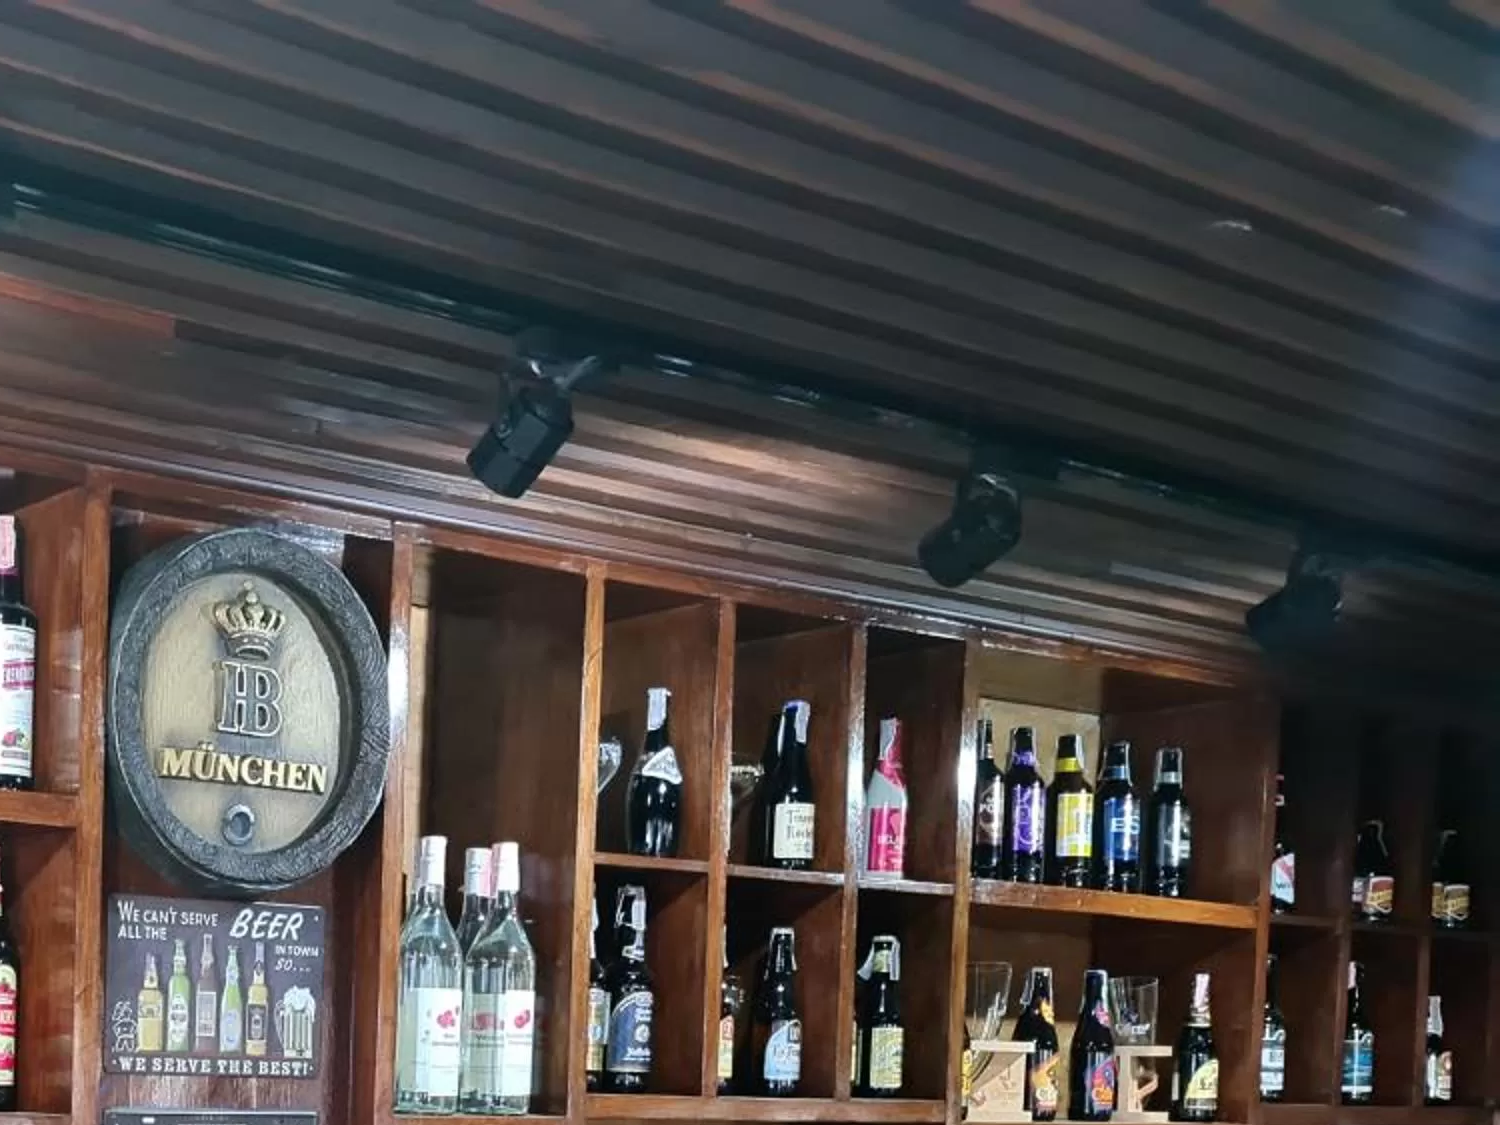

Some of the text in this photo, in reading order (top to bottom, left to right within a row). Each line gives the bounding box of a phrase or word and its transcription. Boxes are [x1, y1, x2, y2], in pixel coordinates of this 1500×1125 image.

[213, 659, 284, 738] HB
[160, 741, 328, 794] MÜNCHEN
[118, 925, 167, 941] ALL THE
[181, 911, 218, 927] SERVE
[230, 908, 304, 941] BEER
[274, 944, 320, 957] IN TOWN
[119, 1056, 147, 1072] WE
[152, 1057, 211, 1074] SERVE
[216, 1058, 253, 1075] THE
